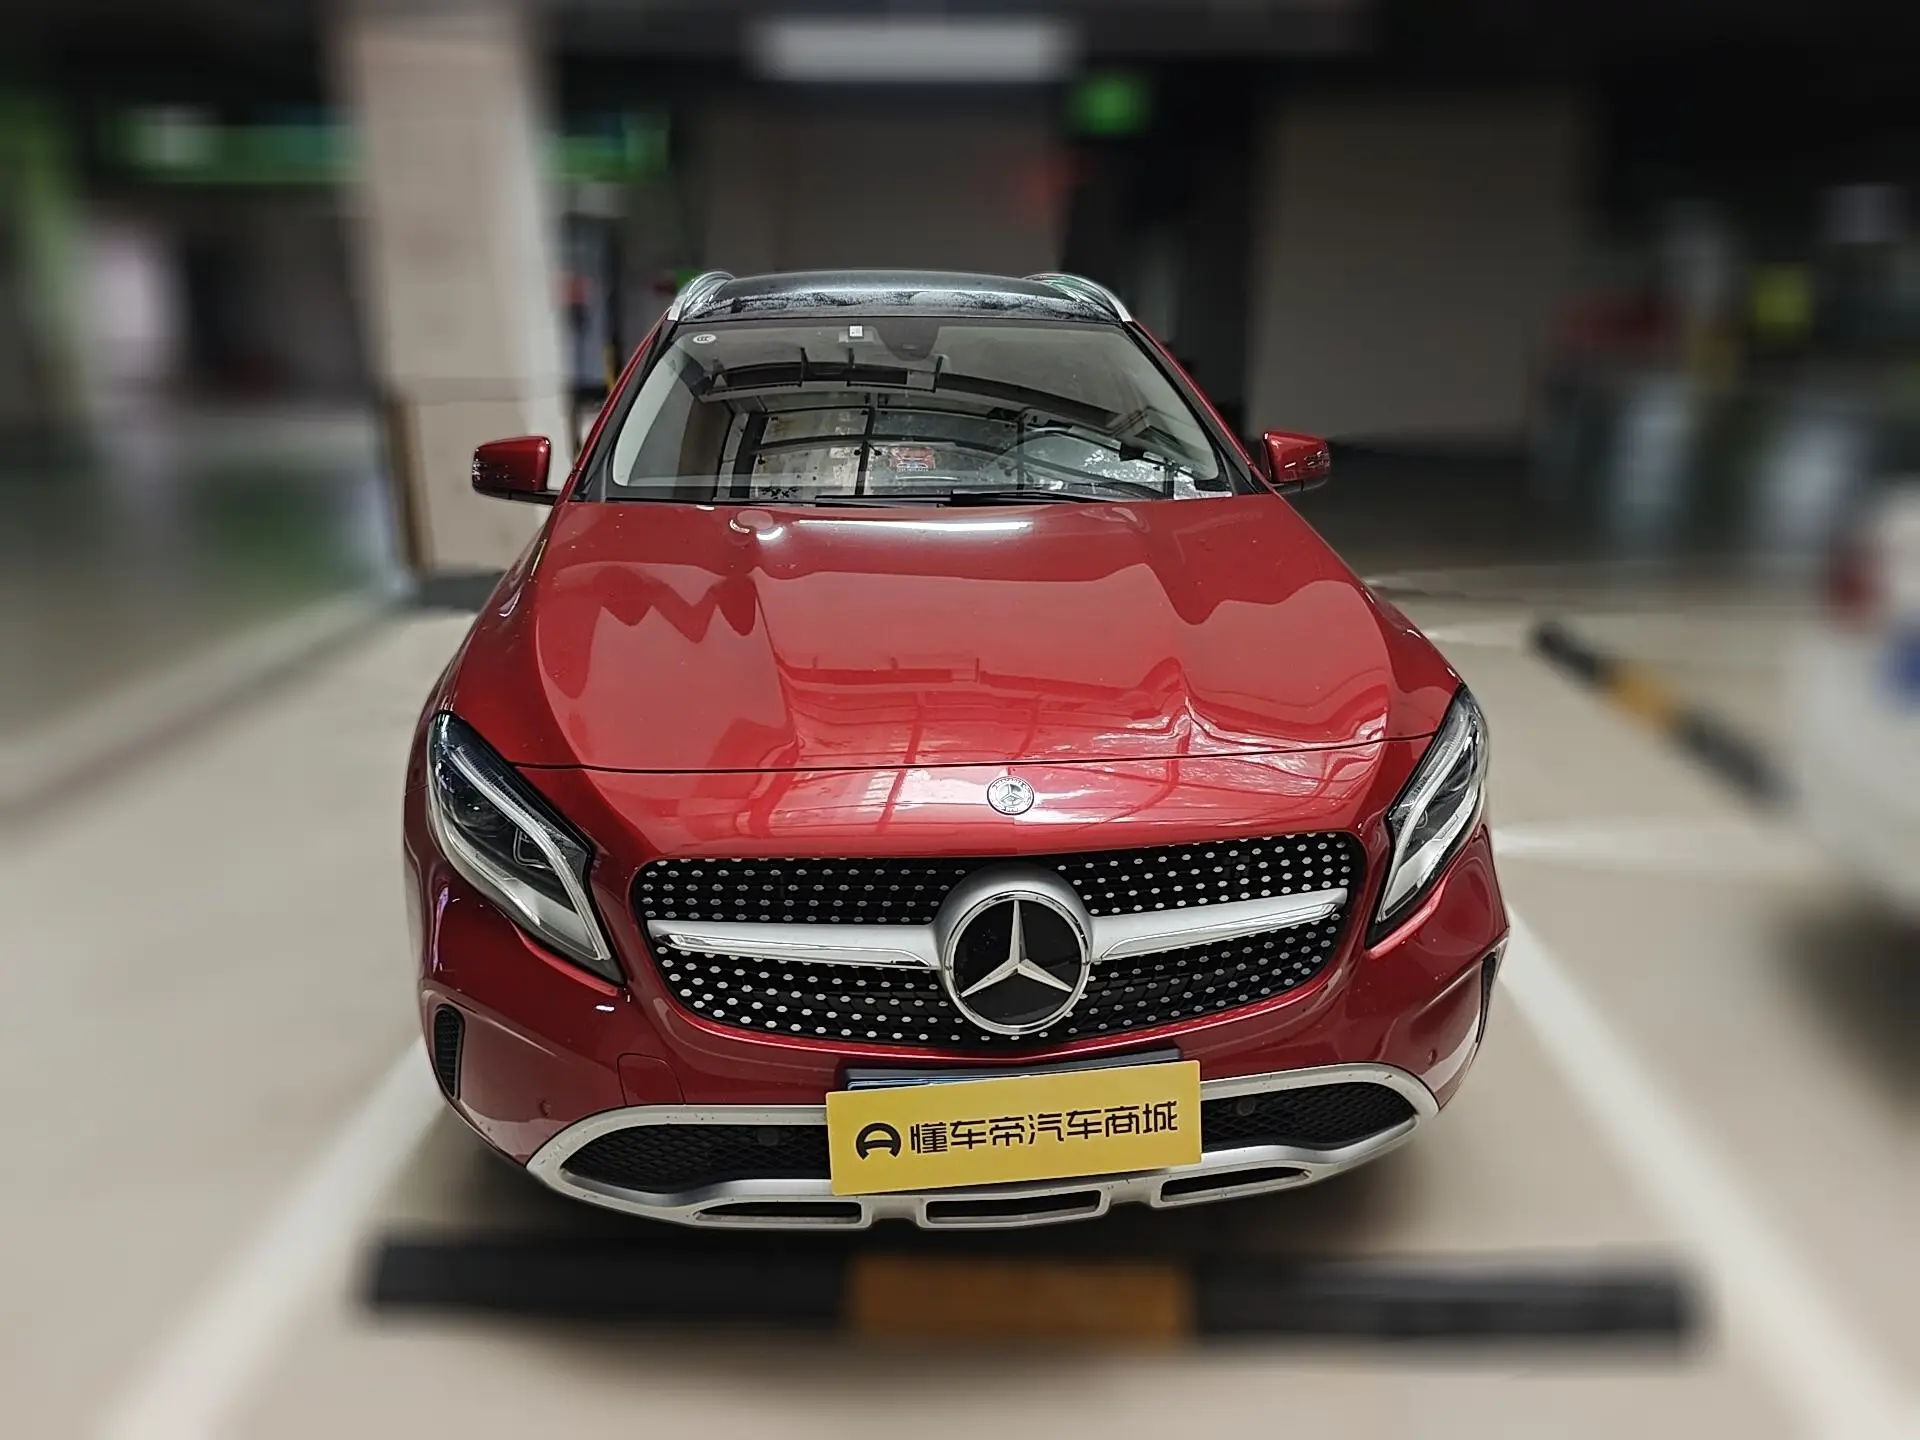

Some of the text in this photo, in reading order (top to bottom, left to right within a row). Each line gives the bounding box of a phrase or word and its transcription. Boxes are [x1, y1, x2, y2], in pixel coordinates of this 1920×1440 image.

[910, 1100, 1178, 1154] 懂车帝汽车商城
